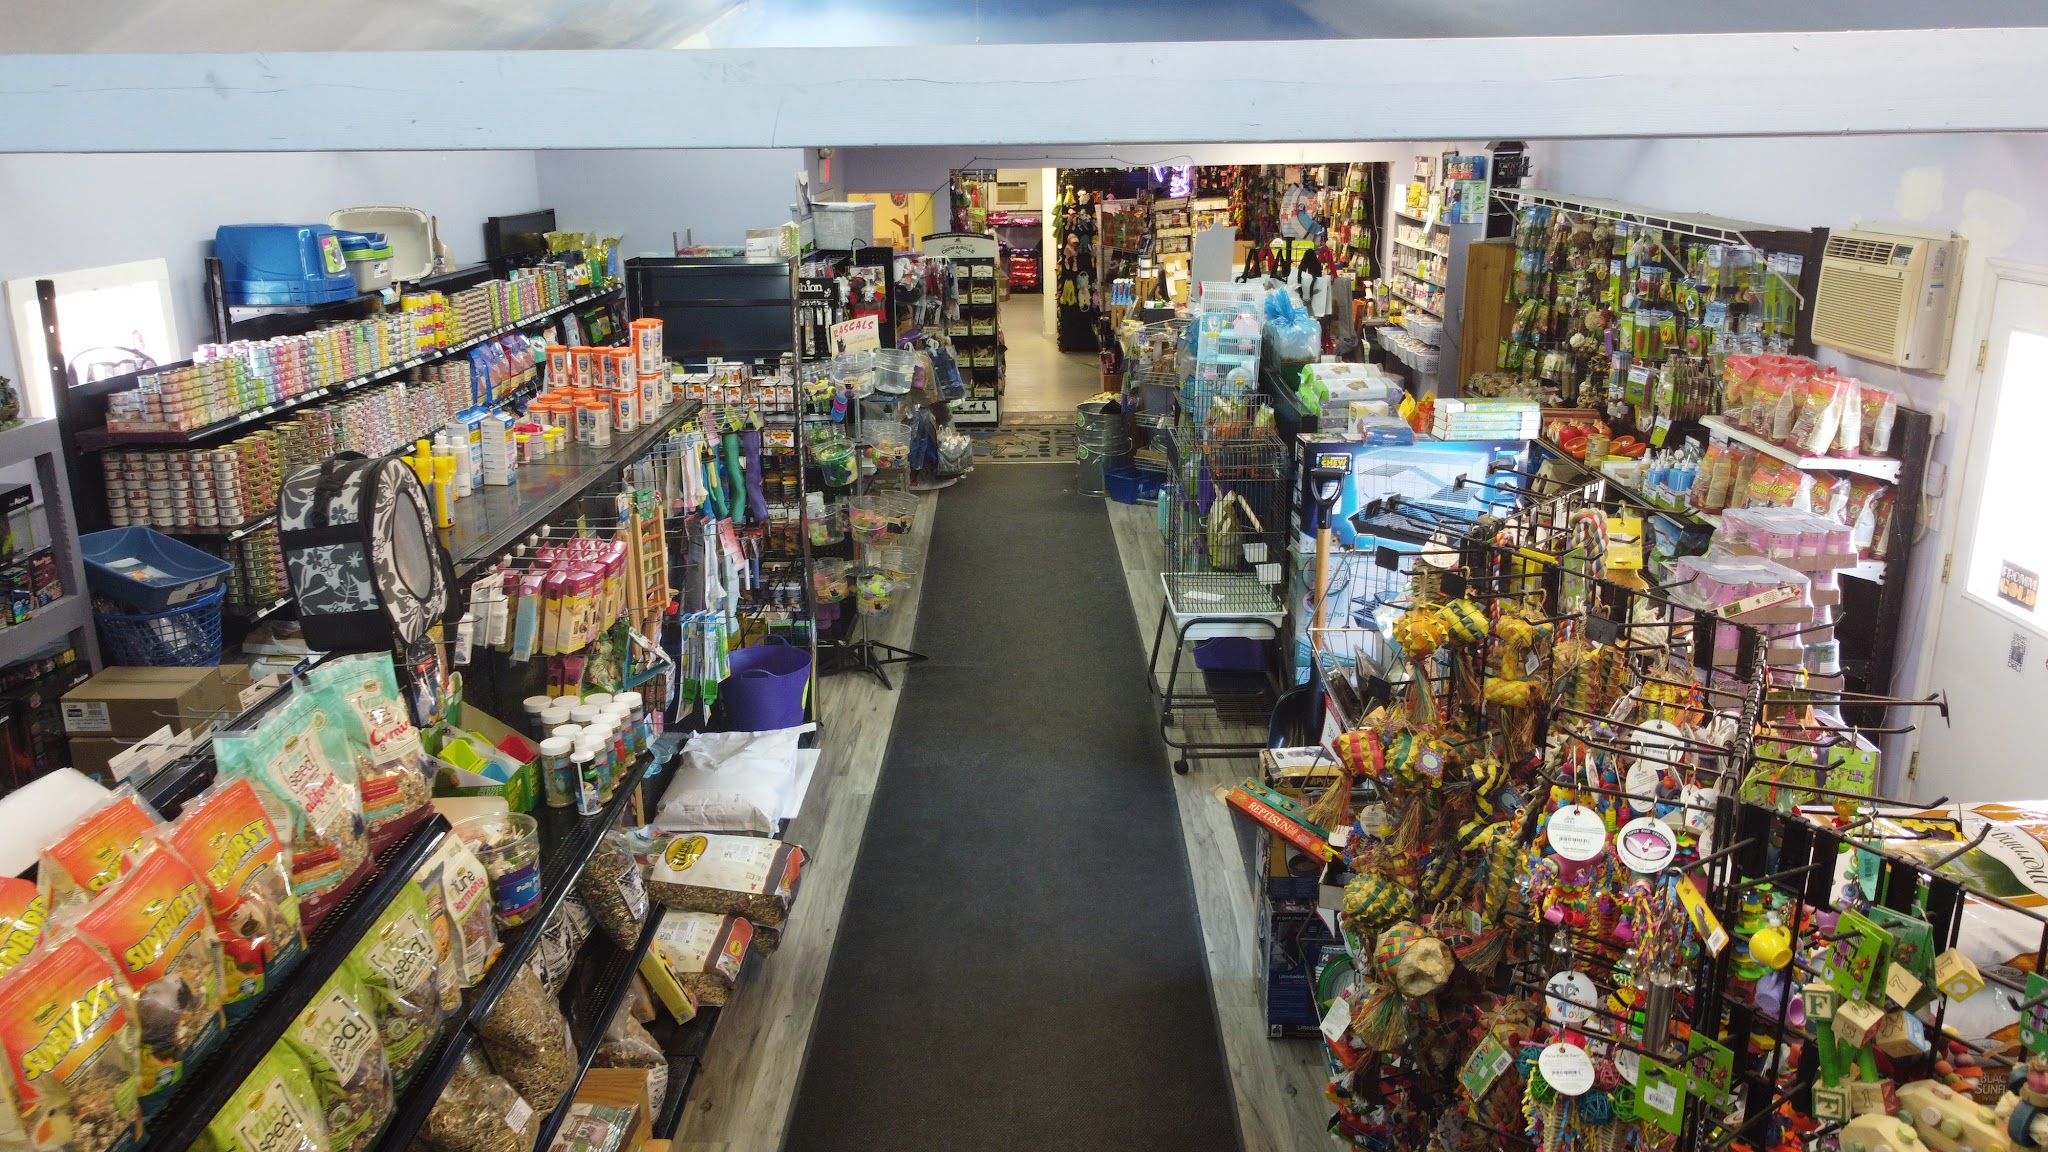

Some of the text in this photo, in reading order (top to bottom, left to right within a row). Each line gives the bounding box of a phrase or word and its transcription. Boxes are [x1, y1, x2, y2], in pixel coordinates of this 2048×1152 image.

[2000, 577, 2036, 606] GOLD
[2001, 565, 2038, 591] FROMM
[1247, 801, 1293, 833] REPTISUN
[206, 818, 275, 893] SUNBURST
[124, 881, 201, 974] SUNBURST
[1809, 993, 1829, 1016] F
[20, 977, 122, 1083] SUNBURST
[1981, 1072, 2007, 1084] BLAC
